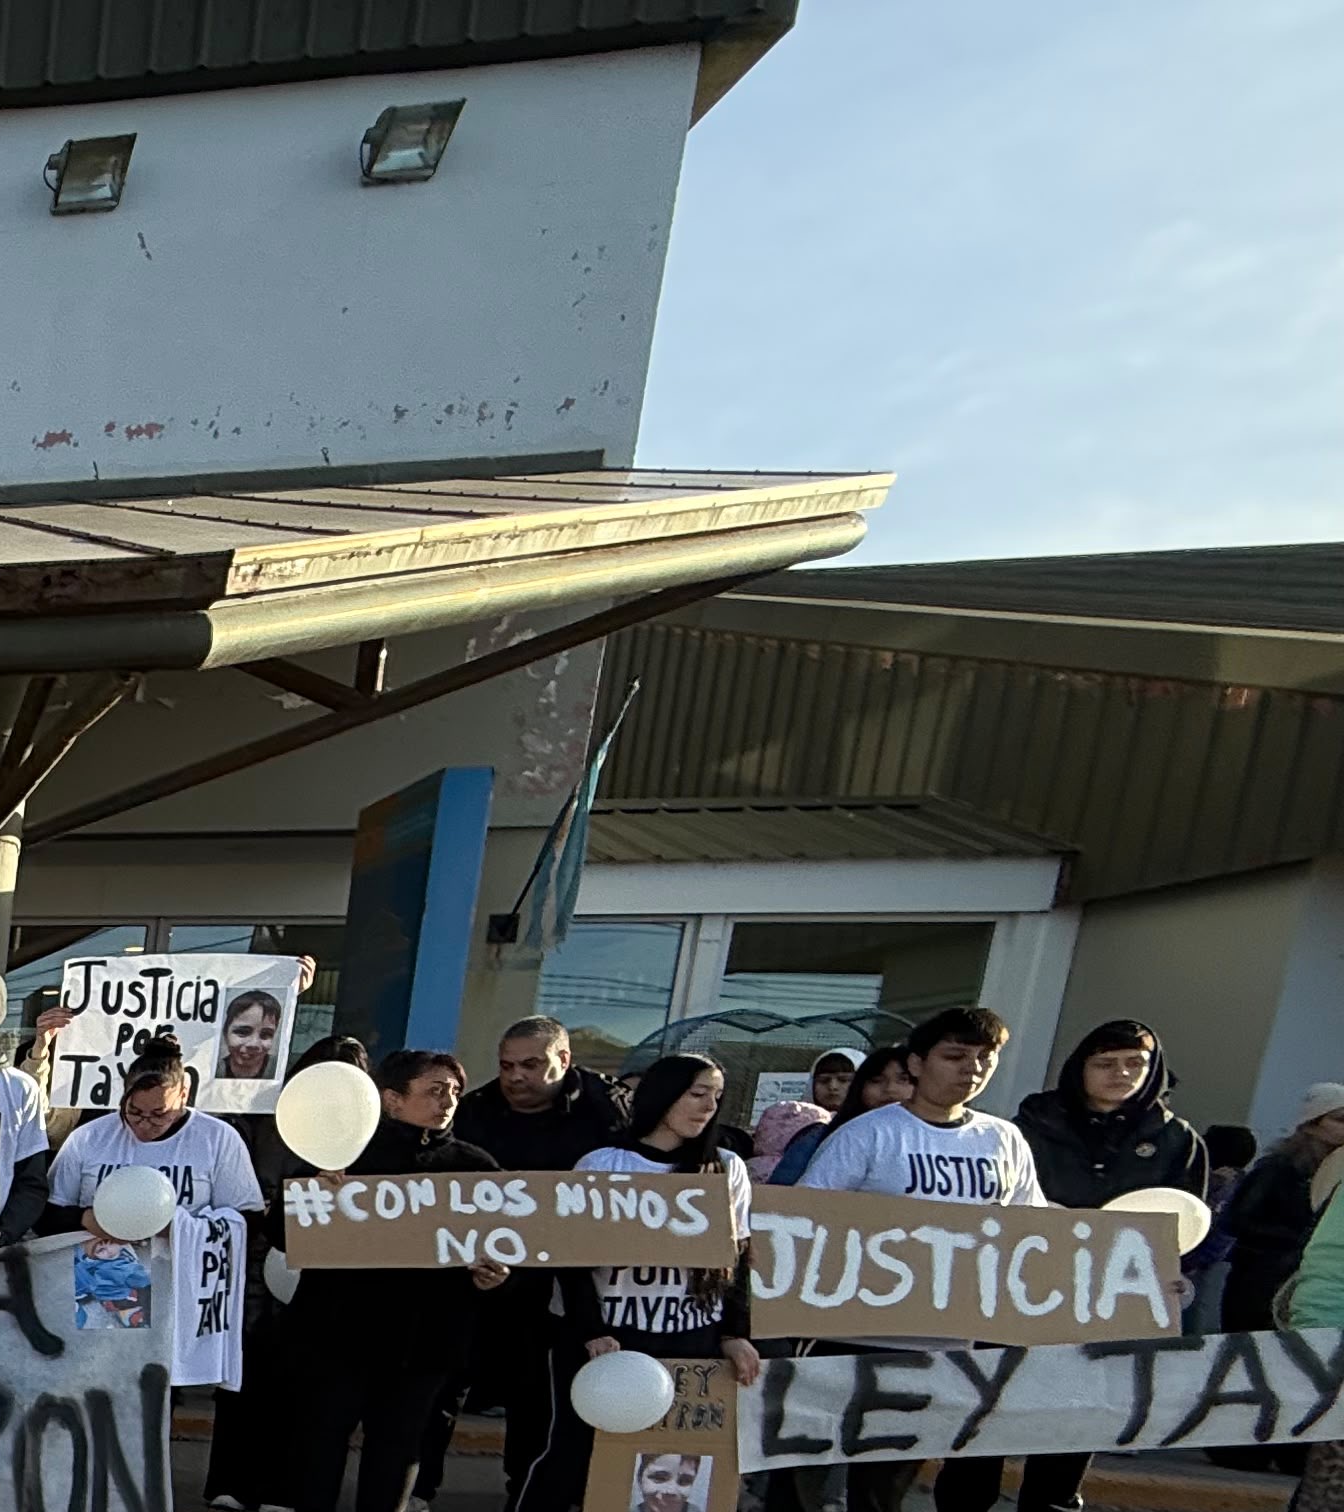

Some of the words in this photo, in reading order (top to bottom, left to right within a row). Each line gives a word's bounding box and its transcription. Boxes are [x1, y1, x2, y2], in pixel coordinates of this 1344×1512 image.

[283, 1178, 437, 1227] #CON
[449, 1179, 537, 1217] LOS
[673, 1361, 721, 1397] EY
[762, 1345, 1028, 1457] LEY
